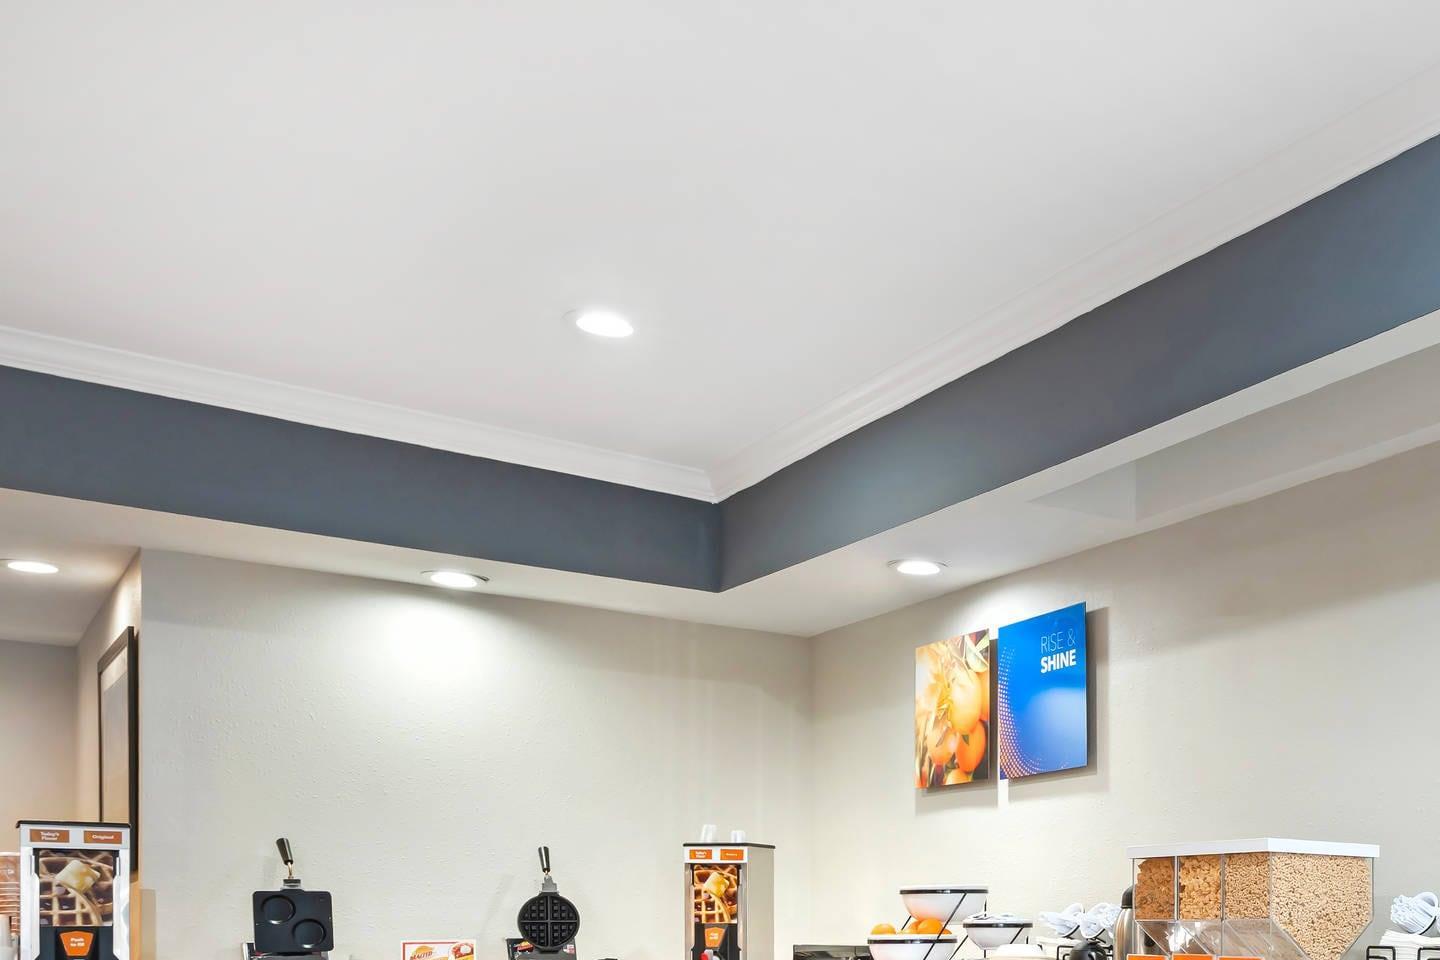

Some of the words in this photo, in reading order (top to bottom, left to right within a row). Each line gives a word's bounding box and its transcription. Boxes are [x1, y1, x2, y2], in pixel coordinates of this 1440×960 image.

[1040, 631, 1064, 654] RISE
[1067, 628, 1076, 647] &
[1040, 648, 1077, 674] SHINE
